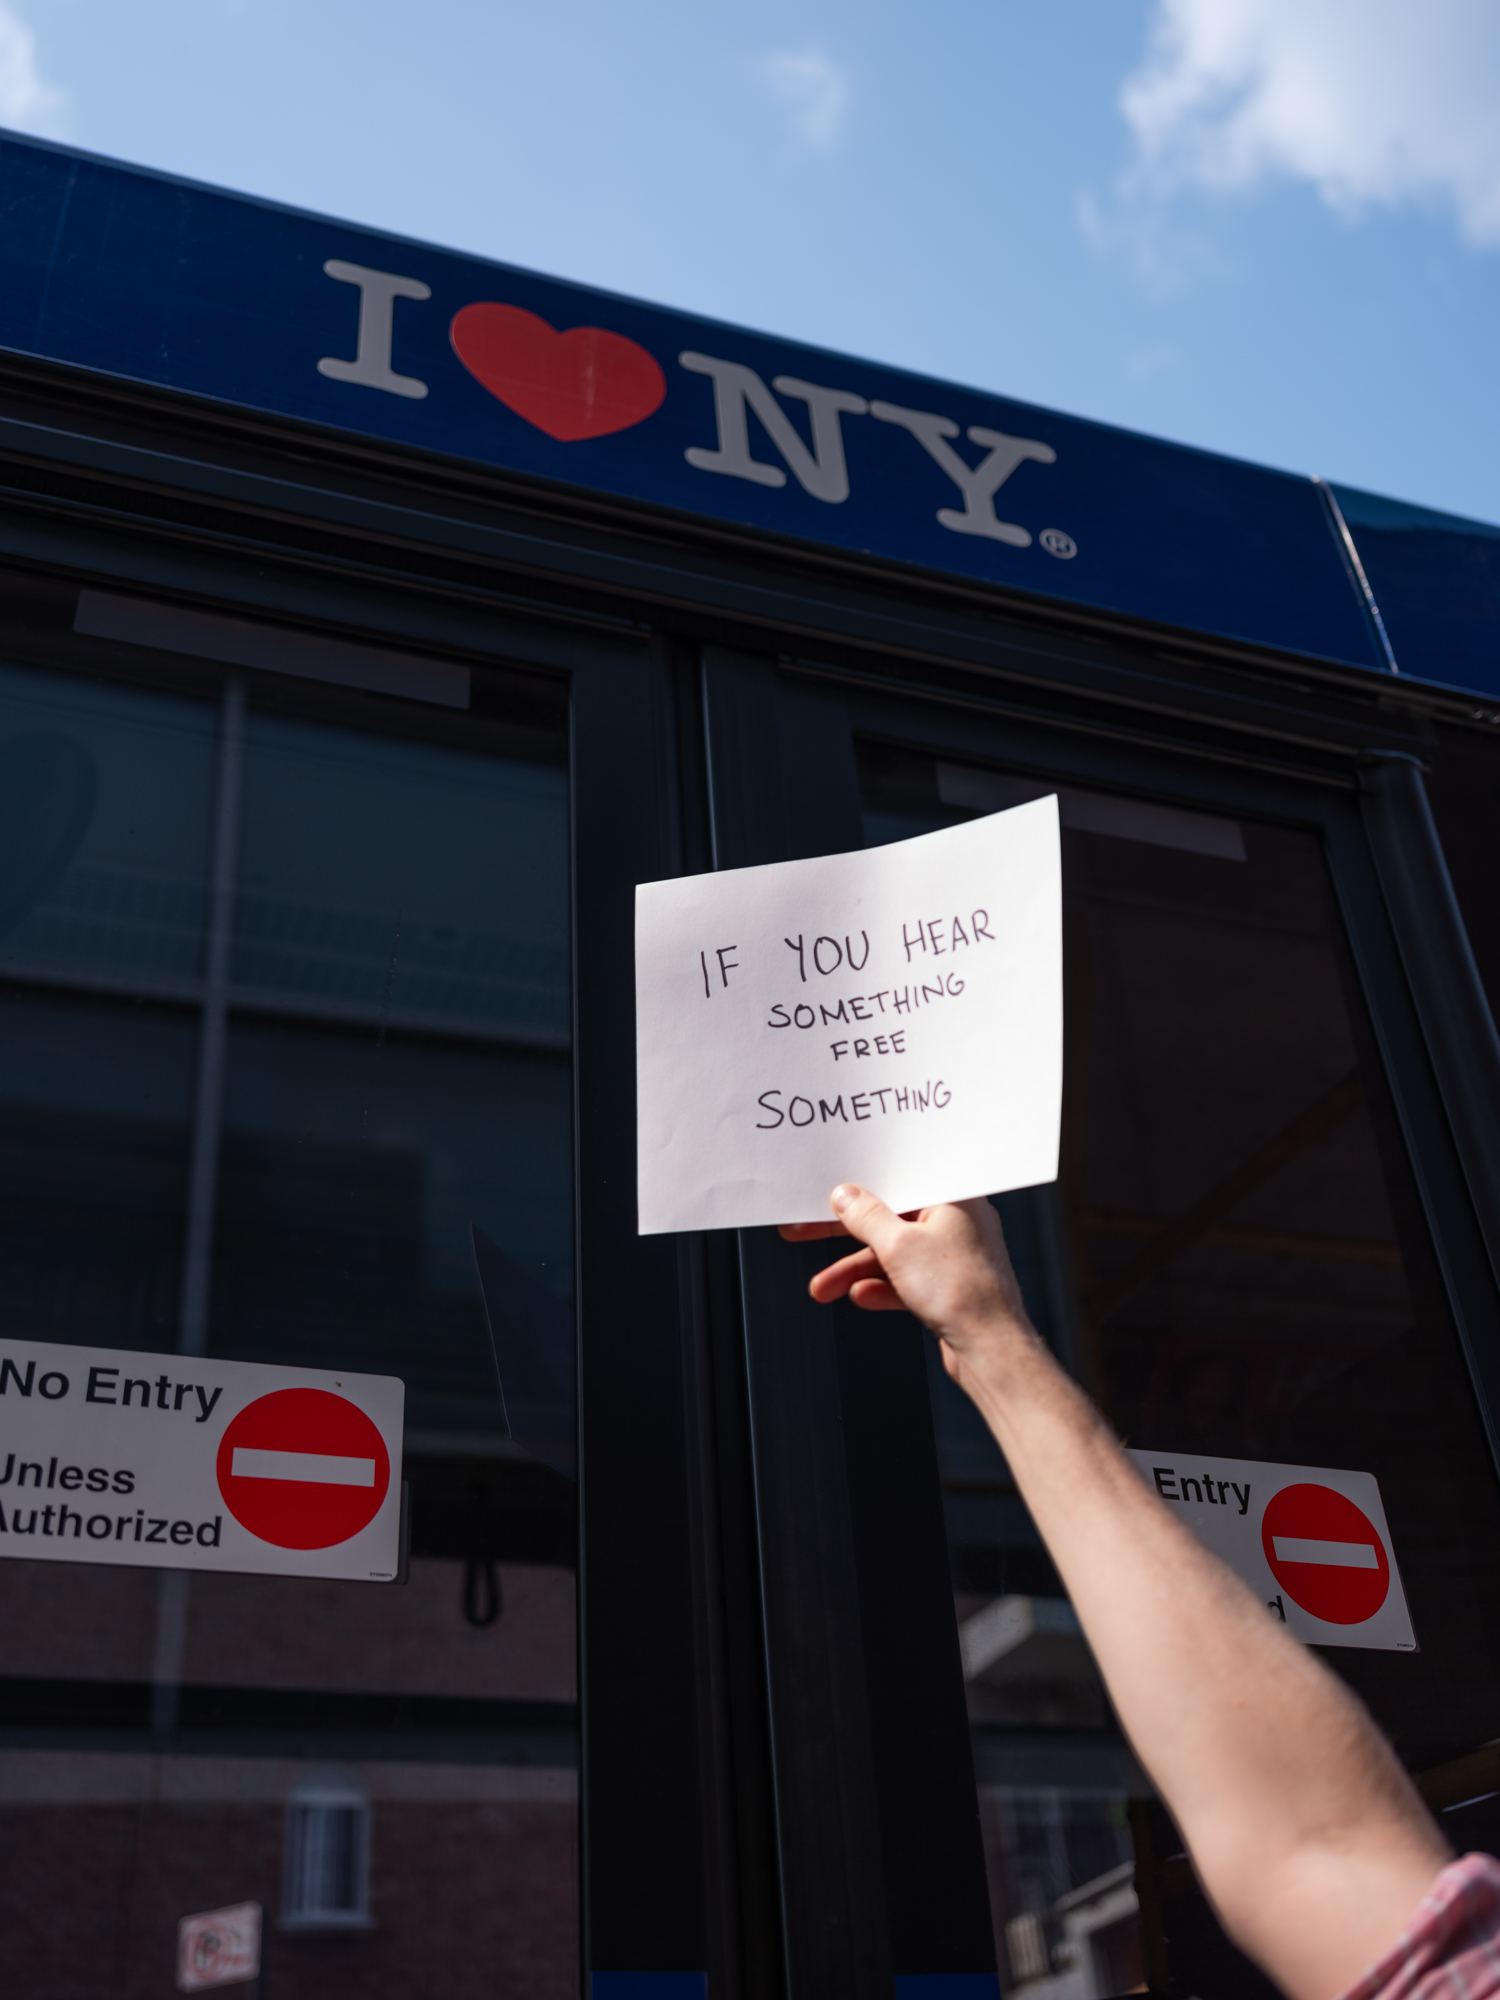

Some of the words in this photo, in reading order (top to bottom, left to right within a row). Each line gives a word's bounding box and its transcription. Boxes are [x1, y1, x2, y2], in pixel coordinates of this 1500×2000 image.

[316, 259, 432, 399] I
[678, 351, 1057, 548] NY
[700, 945, 740, 999] IF
[784, 929, 870, 983] YOU
[902, 908, 996, 963] HEAR
[767, 972, 966, 1029] SOMETHING
[829, 1030, 907, 1061] FREE
[756, 1080, 952, 1129] SOMETHING
[0, 1358, 70, 1400] No
[85, 1366, 224, 1423] Entry
[1152, 1466, 1252, 1516] Entry
